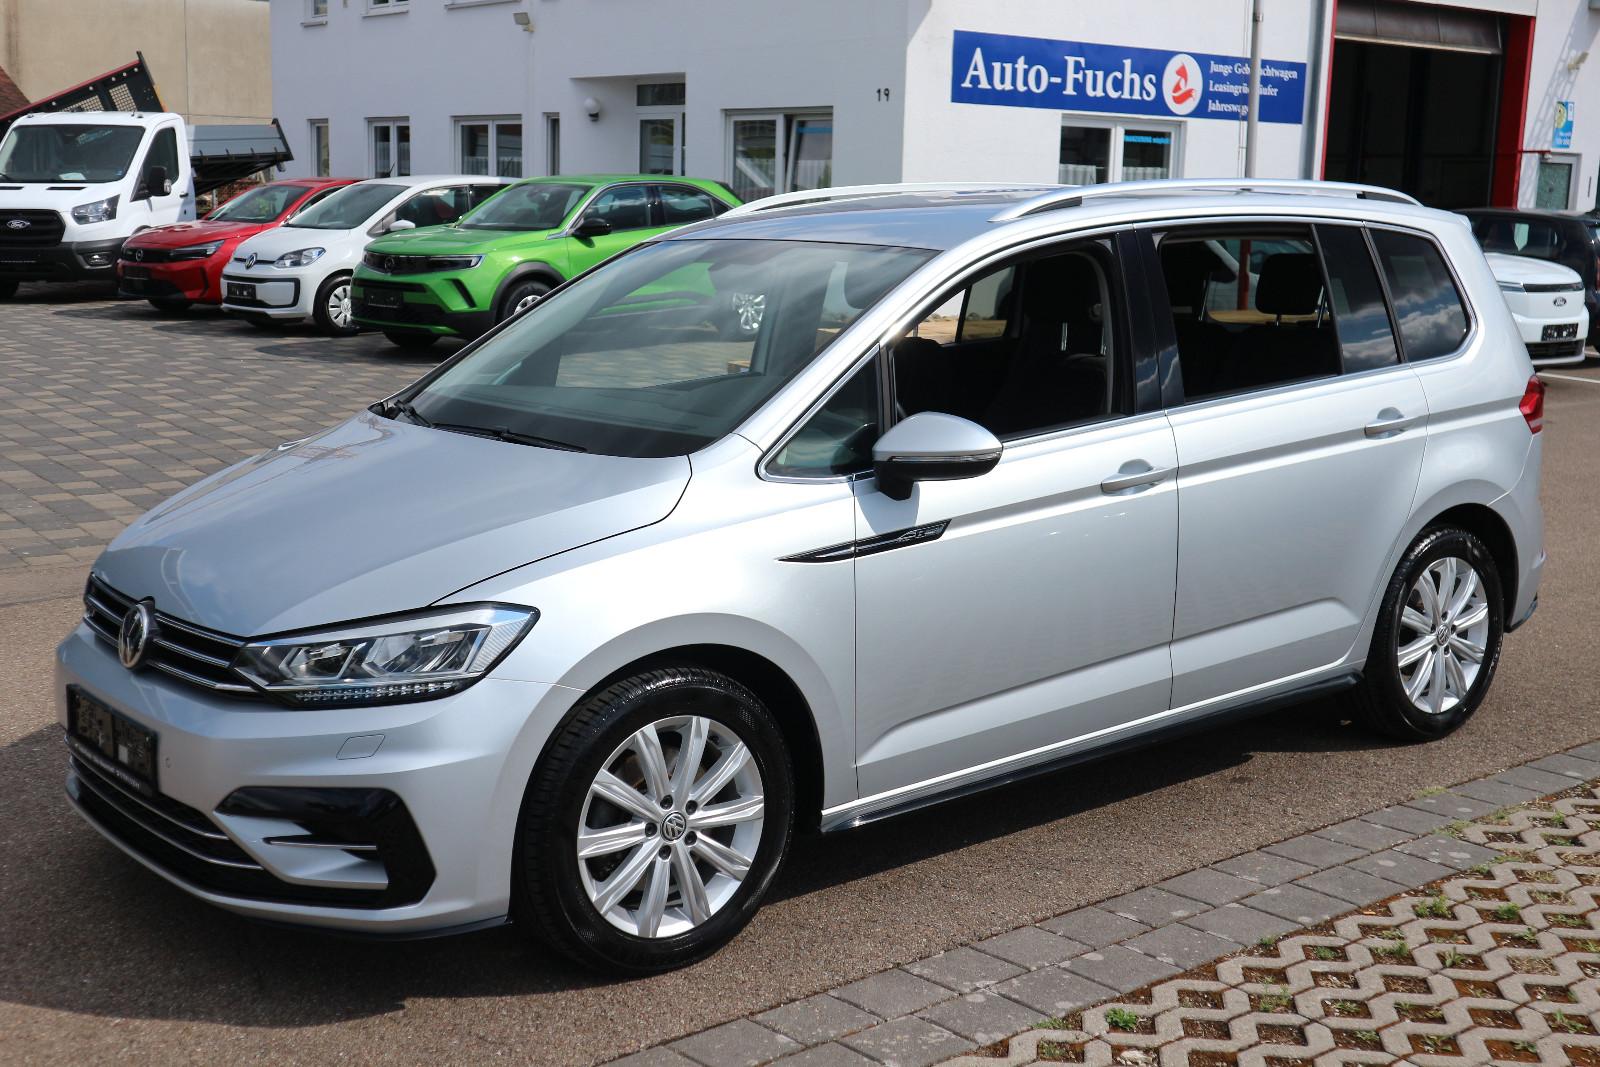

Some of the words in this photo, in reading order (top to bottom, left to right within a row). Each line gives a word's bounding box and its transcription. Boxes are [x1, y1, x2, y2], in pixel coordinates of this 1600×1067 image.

[961, 47, 1157, 101] Auto-Fuchs
[1210, 60, 1233, 76] Junge
[1234, 63, 1298, 81] Gebchtwagen
[876, 87, 890, 102] 19
[1208, 99, 1249, 116] Jahreswag
